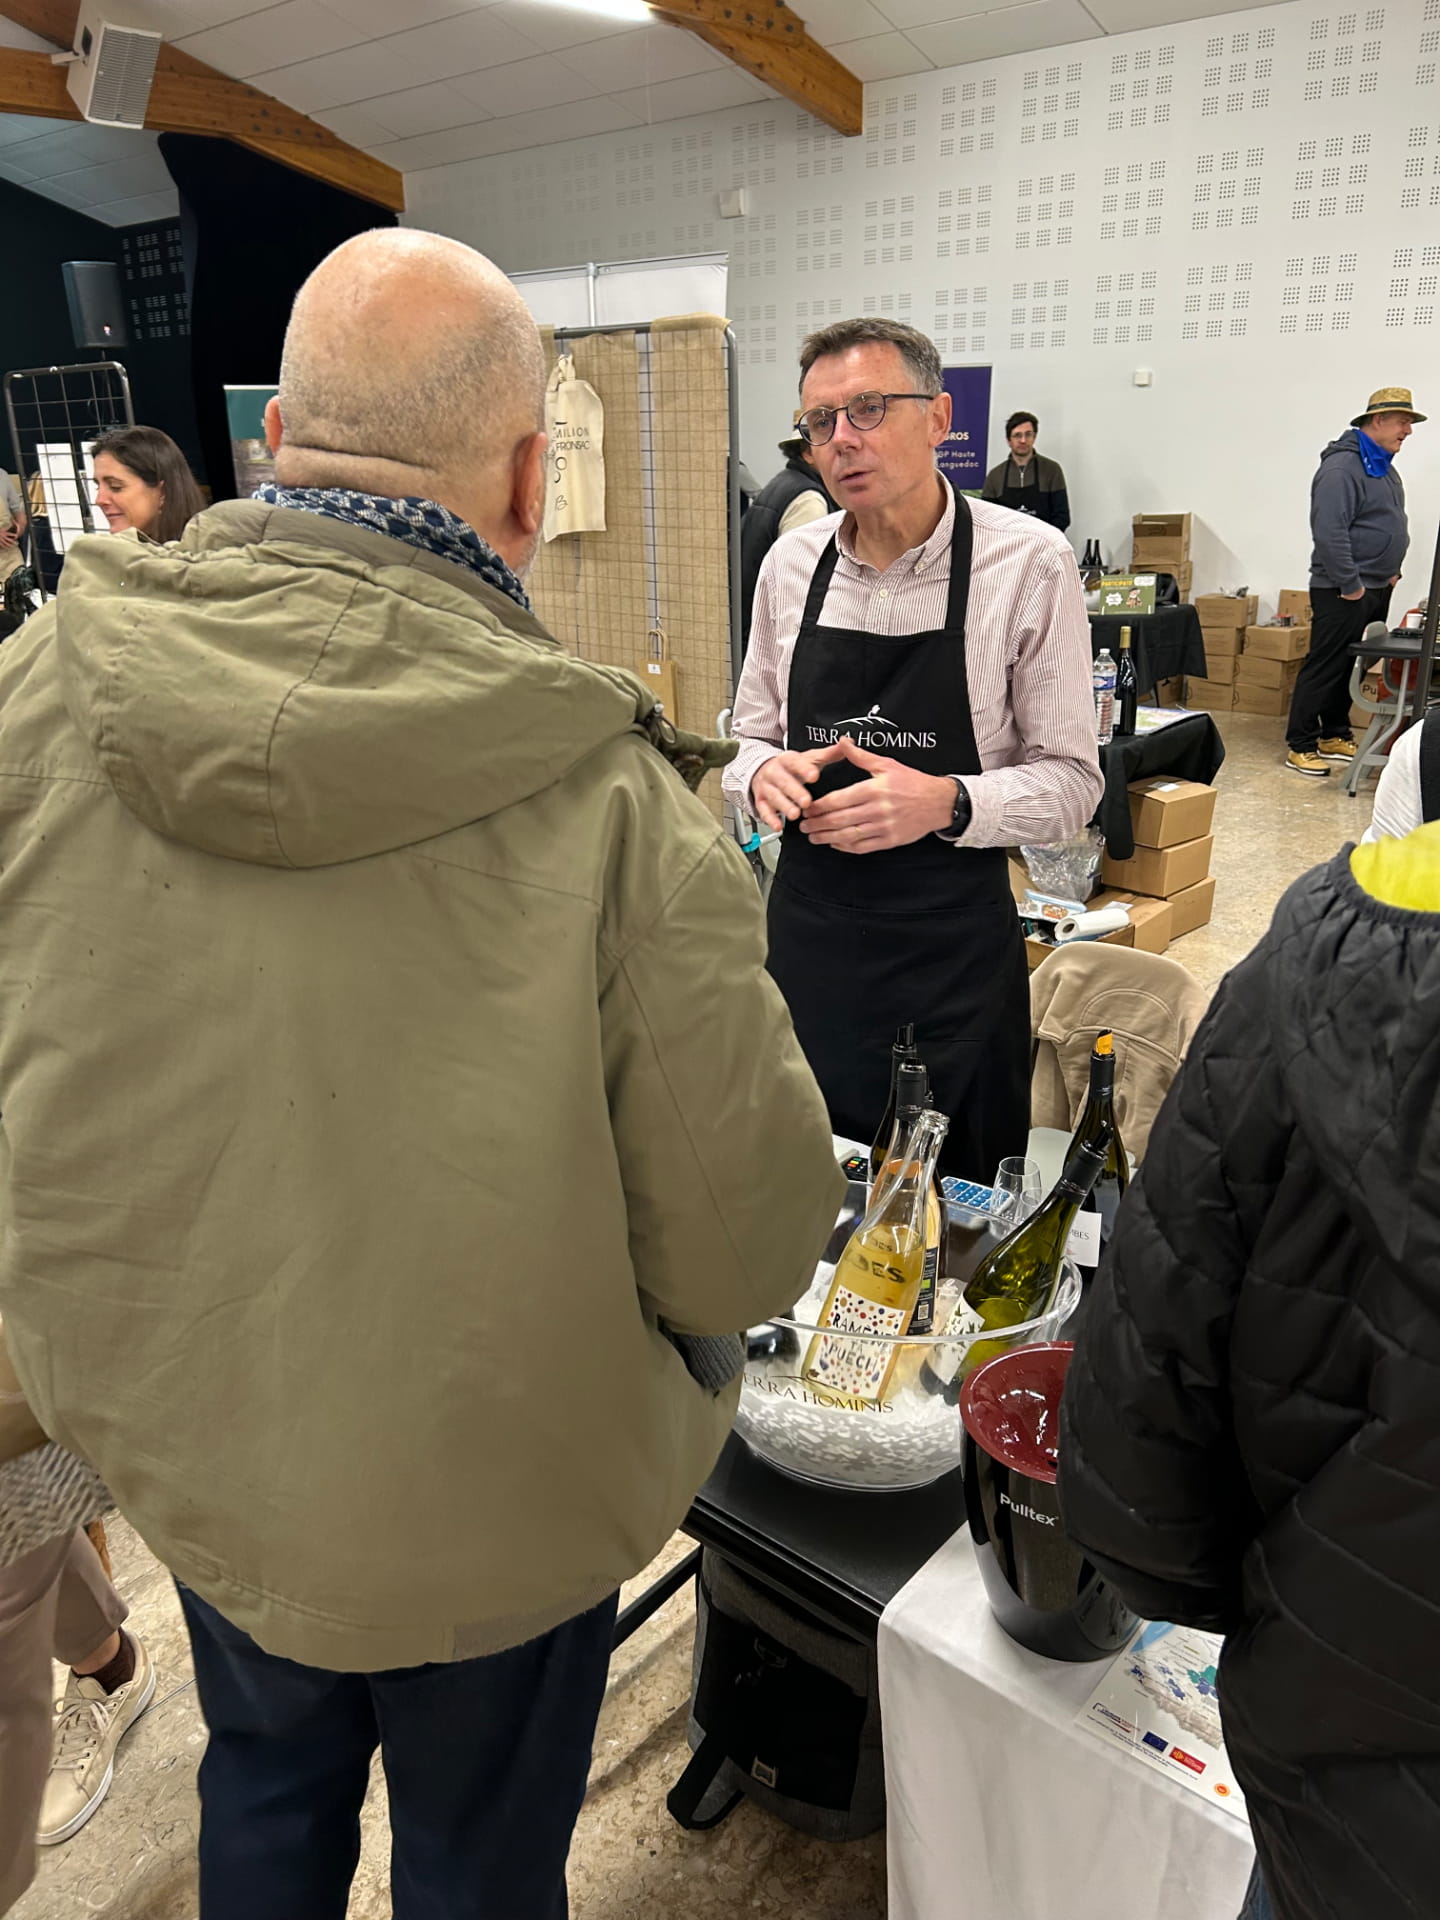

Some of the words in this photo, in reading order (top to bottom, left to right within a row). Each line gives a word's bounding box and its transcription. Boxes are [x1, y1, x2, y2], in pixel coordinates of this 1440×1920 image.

[556, 441, 590, 451] FRONSAC
[857, 731, 937, 748] HOMINIS
[829, 1344, 879, 1371] PUECH
[743, 1373, 797, 1401] ERRA
[803, 1390, 894, 1414] HOMINIS
[1000, 1492, 1056, 1527] Pulltex
